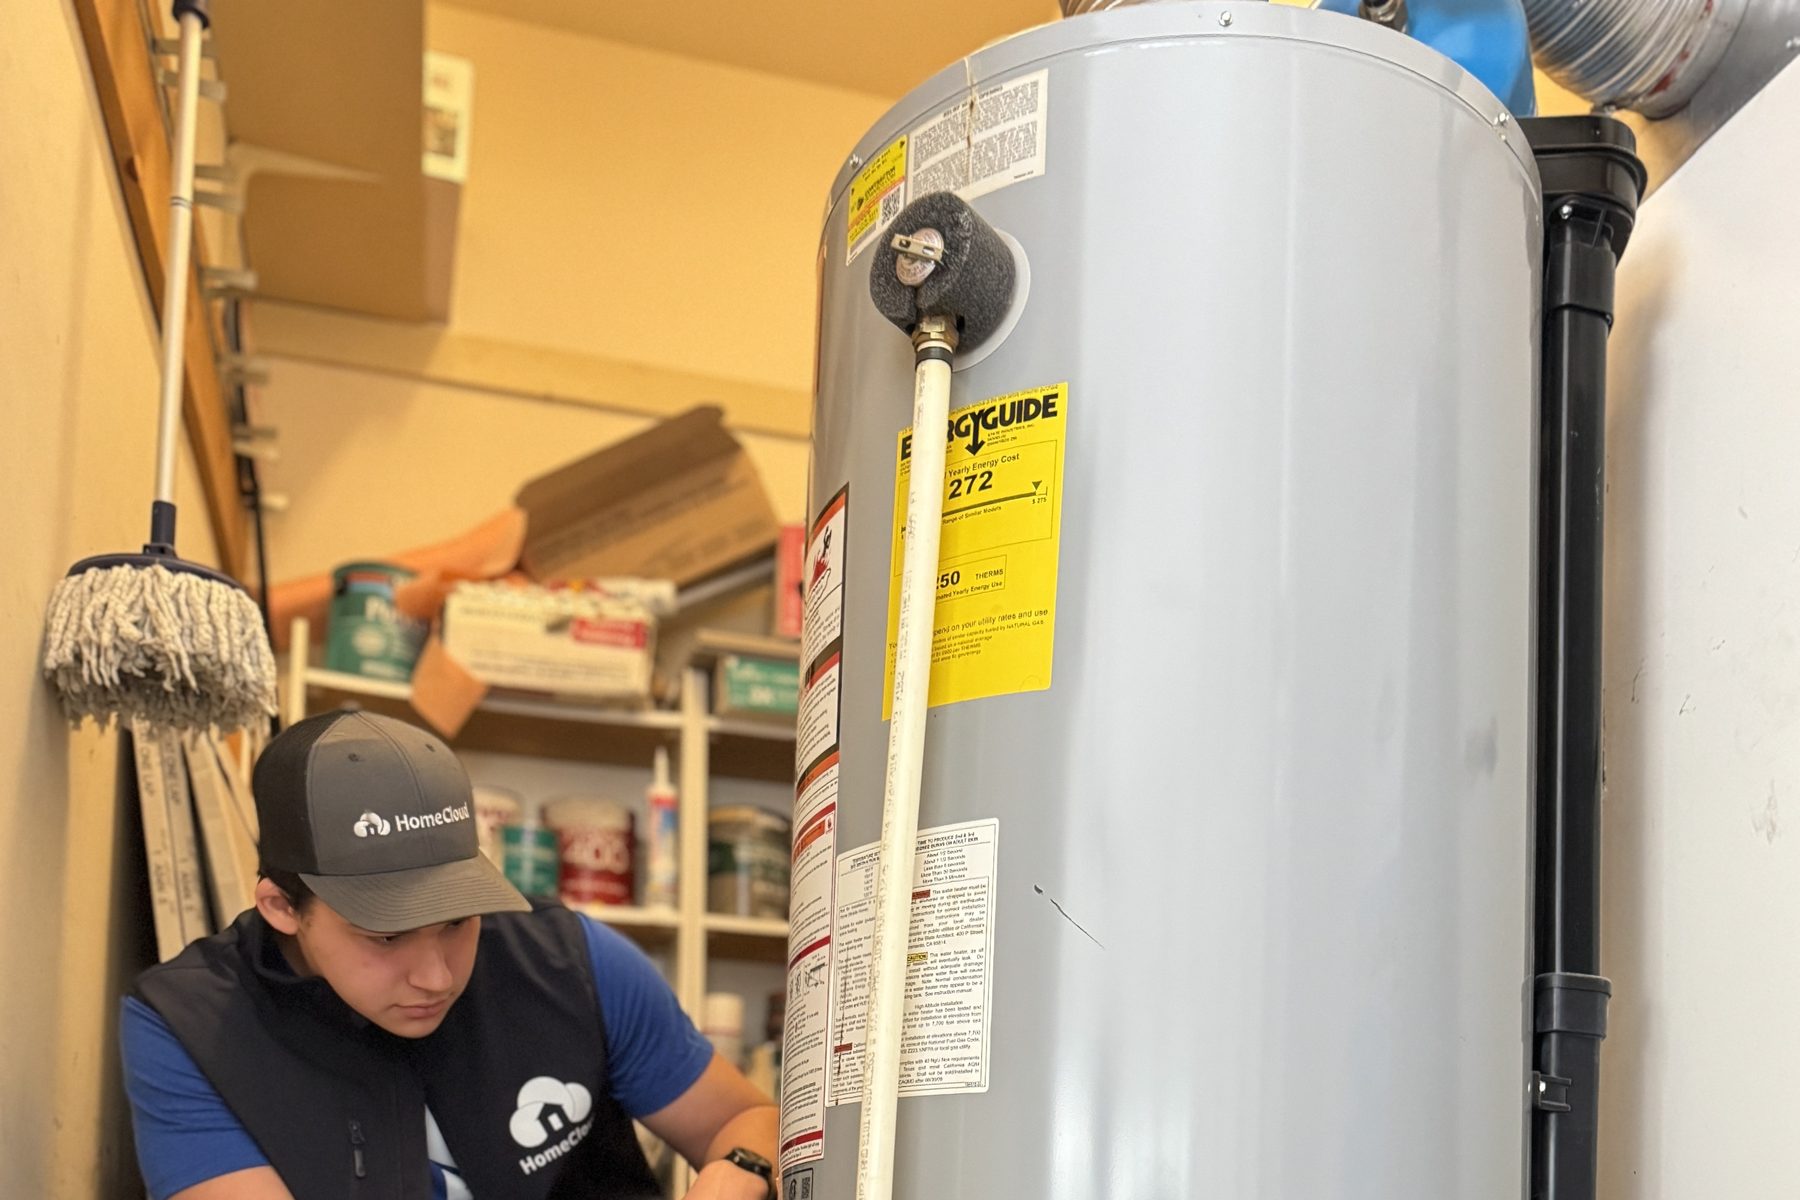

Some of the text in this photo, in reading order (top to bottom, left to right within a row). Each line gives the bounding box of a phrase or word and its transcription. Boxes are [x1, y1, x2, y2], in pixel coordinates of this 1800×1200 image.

[901, 393, 1058, 460] ERGYGUIDE
[949, 453, 1020, 479] Yearly Energy Cost
[949, 470, 993, 500] 272
[976, 568, 1003, 580] THERMS
[953, 586, 969, 597] Yearly
[971, 582, 990, 592] Energy
[951, 622, 960, 631] on
[961, 620, 977, 631] your
[978, 615, 997, 627] utility
[998, 612, 1017, 622] rates
[1018, 610, 1033, 619] and
[1034, 609, 1049, 617] use
[395, 802, 470, 832] HomeCloud
[519, 1113, 594, 1175] HomeClo
